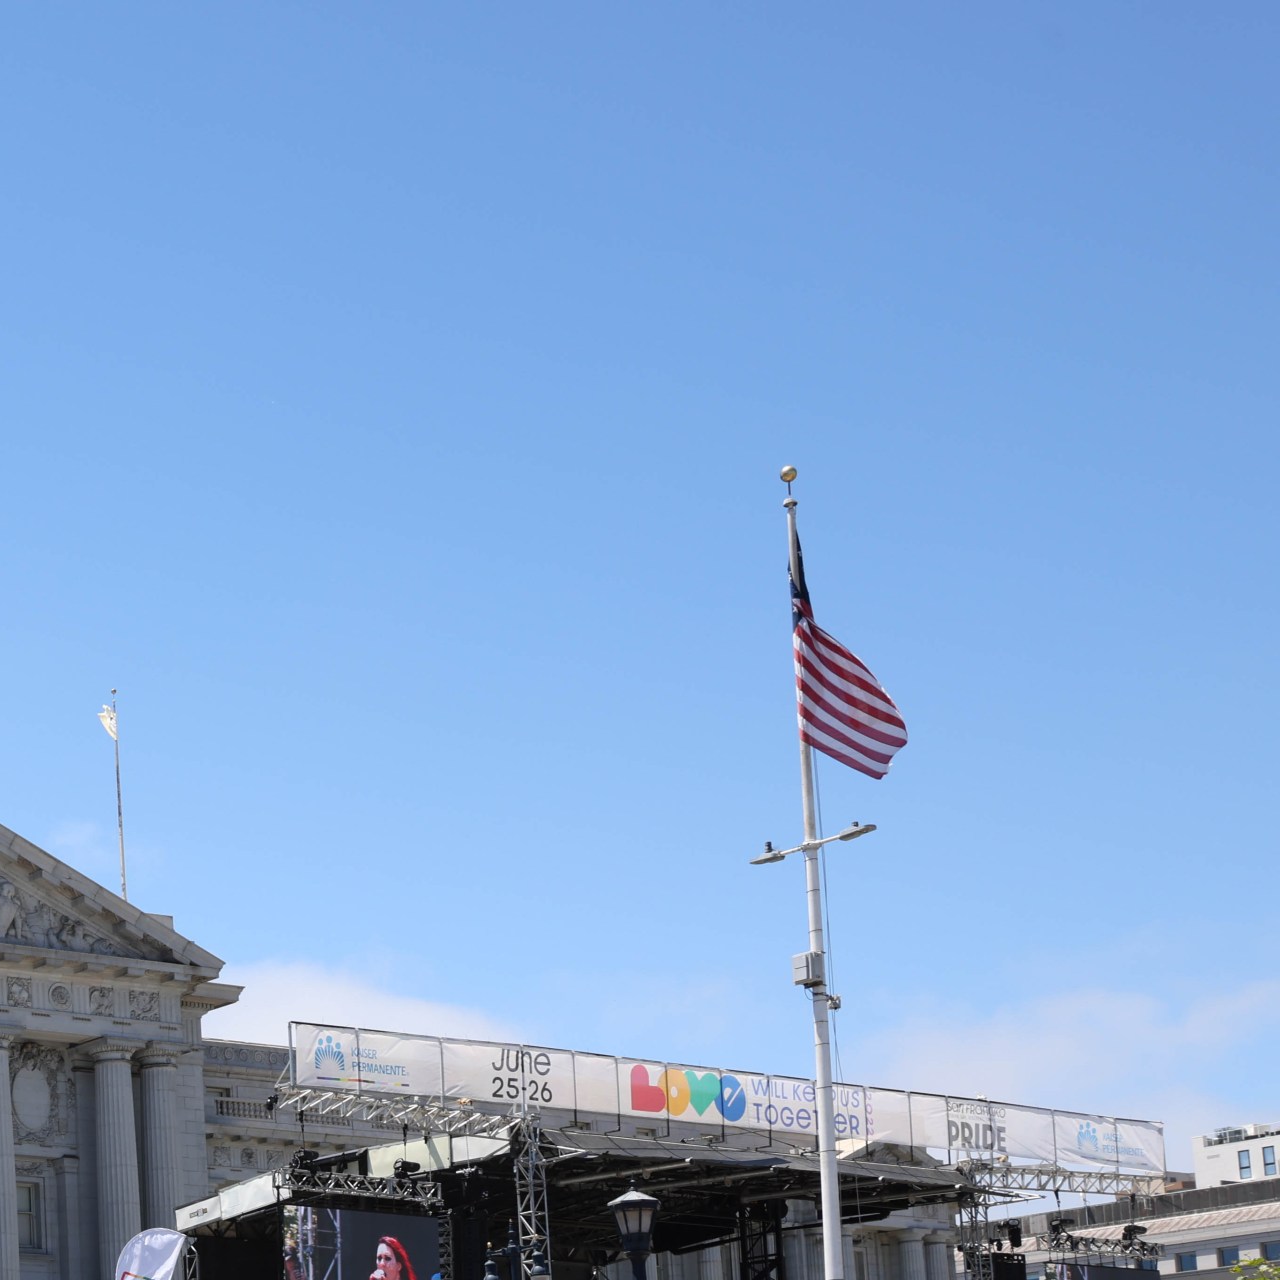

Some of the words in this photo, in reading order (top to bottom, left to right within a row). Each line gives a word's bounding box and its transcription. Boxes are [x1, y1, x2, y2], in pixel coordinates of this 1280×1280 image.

[351, 1046, 378, 1060] KAISER
[351, 1061, 407, 1076] PERMANENTE
[491, 1076, 552, 1103] 25-26
[751, 1078, 788, 1100] WILL
[840, 1089, 860, 1108] US
[948, 1119, 1007, 1153] PRIDE
